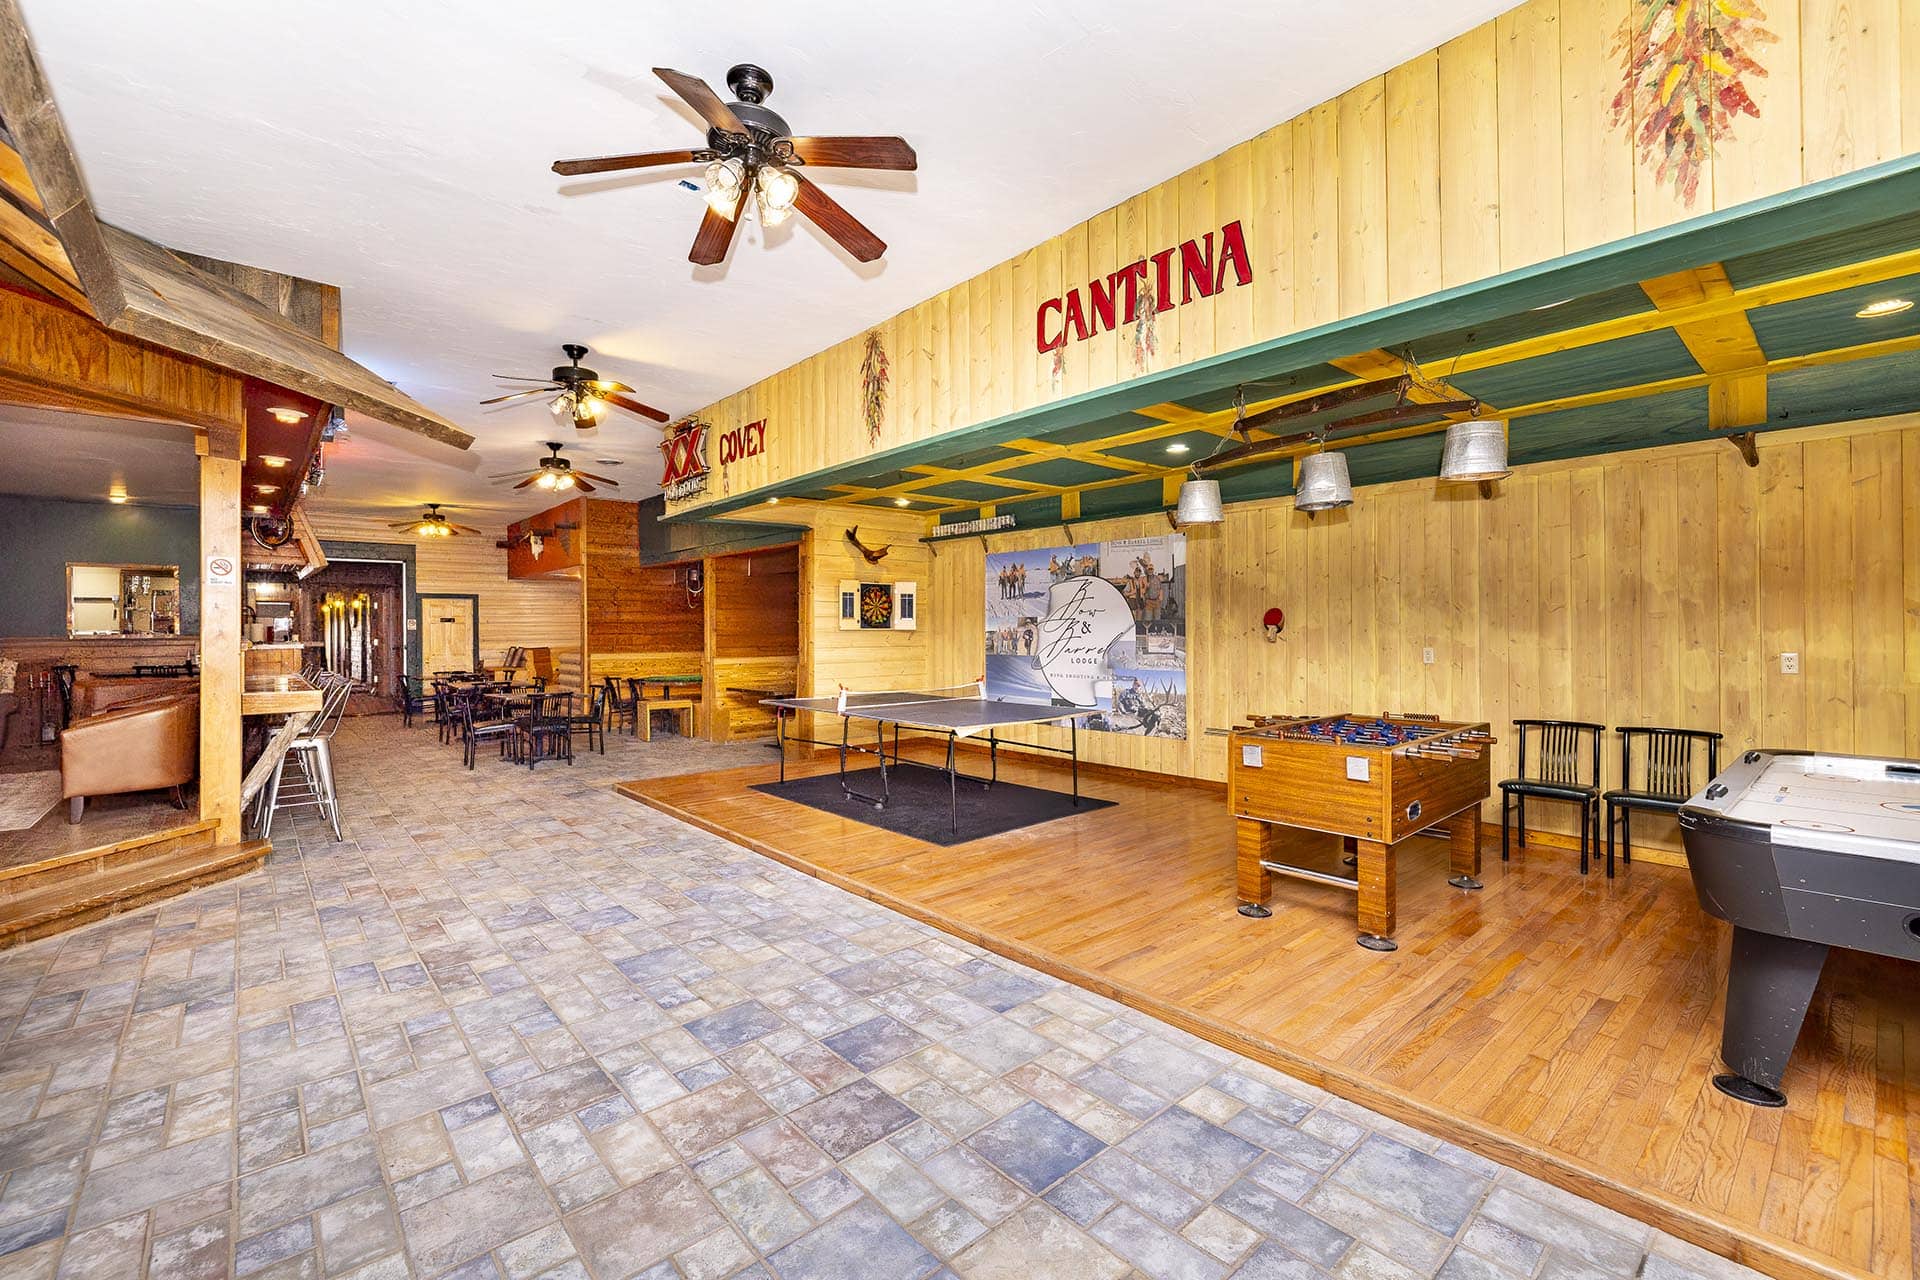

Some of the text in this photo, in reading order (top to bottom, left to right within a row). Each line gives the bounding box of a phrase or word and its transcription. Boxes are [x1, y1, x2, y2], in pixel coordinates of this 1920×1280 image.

[1037, 219, 1253, 354] CANTINA
[660, 424, 704, 488] XX
[719, 418, 768, 466] COVEY
[1036, 579, 1106, 632] Bow
[1080, 621, 1092, 634] &
[1032, 619, 1135, 670] Barrel
